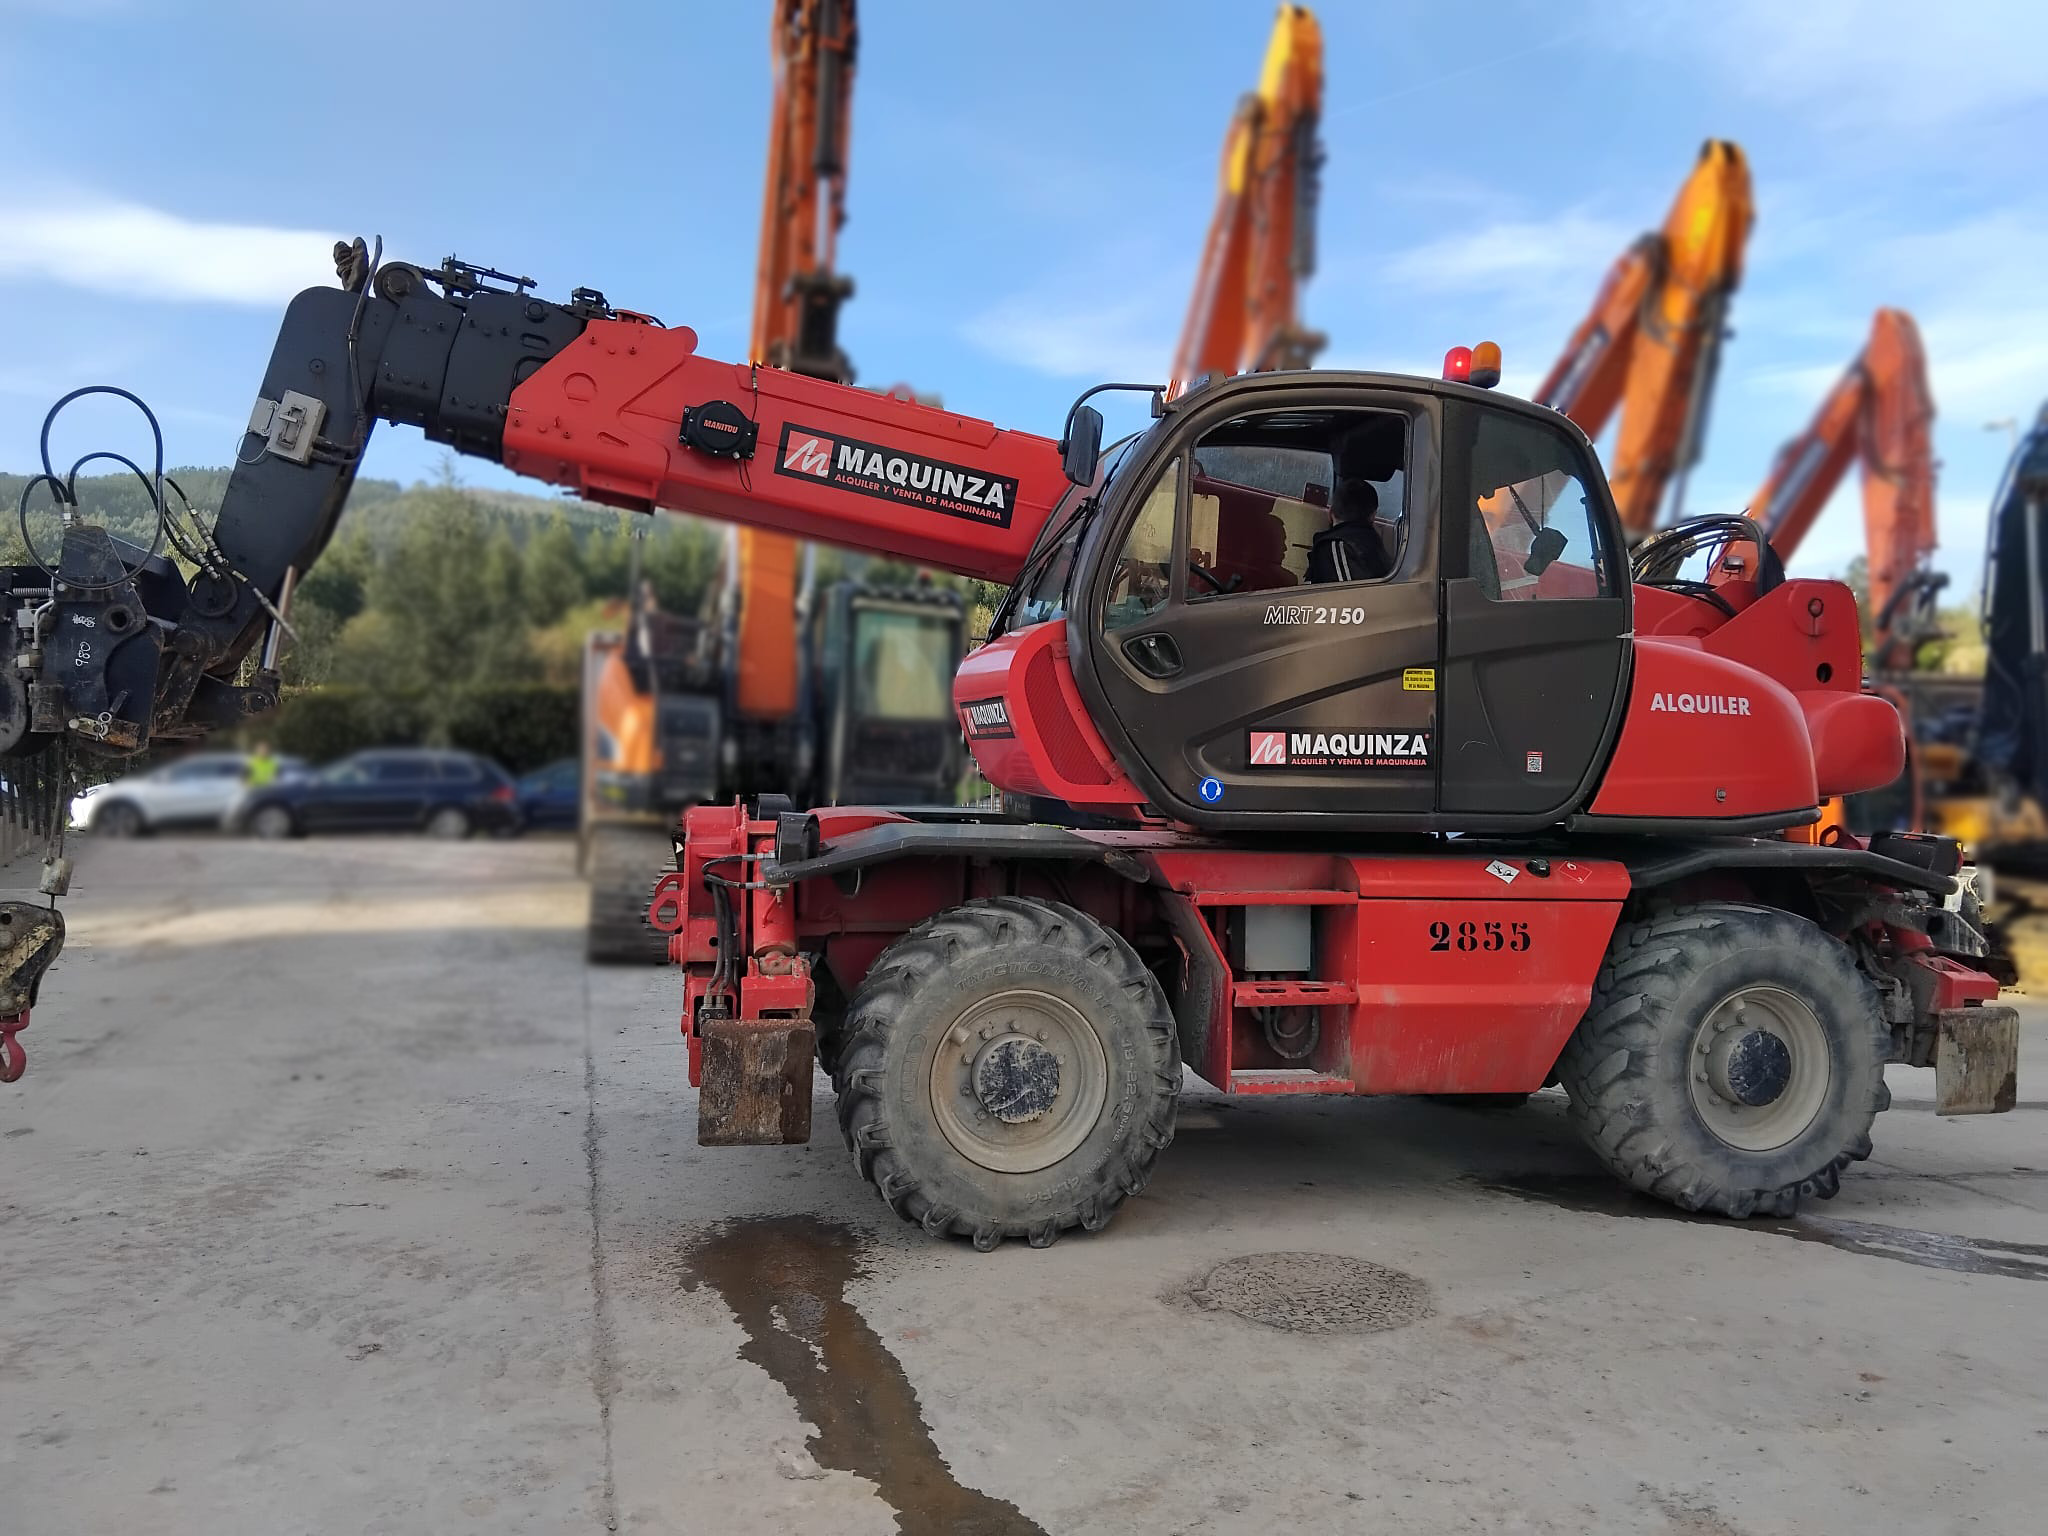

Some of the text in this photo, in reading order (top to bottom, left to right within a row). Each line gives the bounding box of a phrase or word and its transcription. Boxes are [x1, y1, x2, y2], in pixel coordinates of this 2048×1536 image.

[703, 419, 739, 434] MANITOU
[837, 444, 1005, 508] MAQUINZA
[834, 473, 1002, 521] ALQUILER Y VENTA DE MAQUINARIA
[970, 702, 1008, 726] MAQUINZA
[1650, 693, 1752, 716] ALQUILER
[1291, 733, 1428, 756] MAQUINZA
[1291, 758, 1427, 766] ALQUILER Y VENTA DE MAQUINARIA
[1429, 921, 1531, 952] 2855
